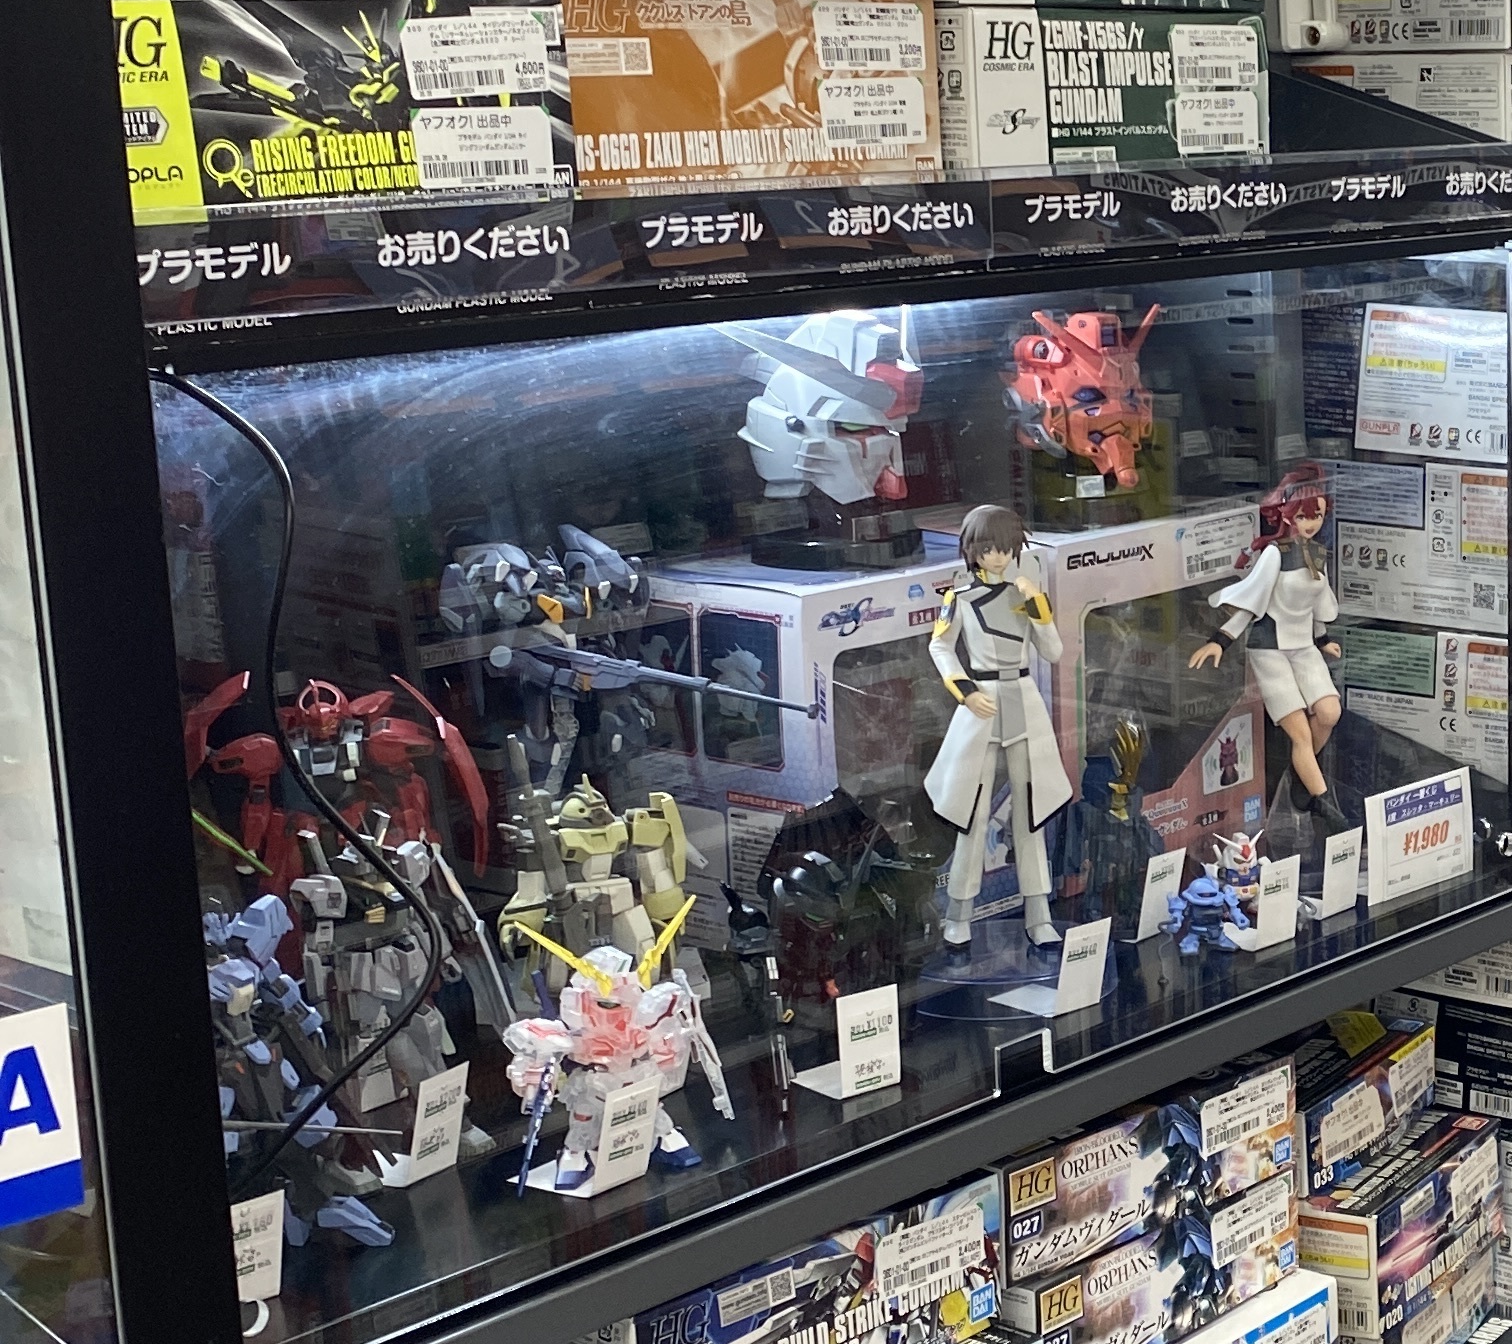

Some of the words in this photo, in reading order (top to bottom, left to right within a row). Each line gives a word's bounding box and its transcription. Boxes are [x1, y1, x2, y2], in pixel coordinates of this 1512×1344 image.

[984, 21, 1034, 60] HG
[1046, 51, 1099, 86] BLAST
[1103, 51, 1173, 86] IMPULSE
[1050, 87, 1123, 124] GUNDAM
[1024, 191, 1121, 223] プラモデル
[1170, 182, 1287, 212] お売りください
[643, 212, 763, 248] プラモデル
[828, 200, 974, 236] お売りください
[377, 227, 571, 267] お売りください
[1403, 822, 1449, 853] ¥1,980
[1061, 1136, 1138, 1181] ORPHANS
[1012, 1218, 1040, 1239] 027
[1014, 1199, 1149, 1265] ガンダムヴィダール
[832, 1299, 894, 1343] STRIKE
